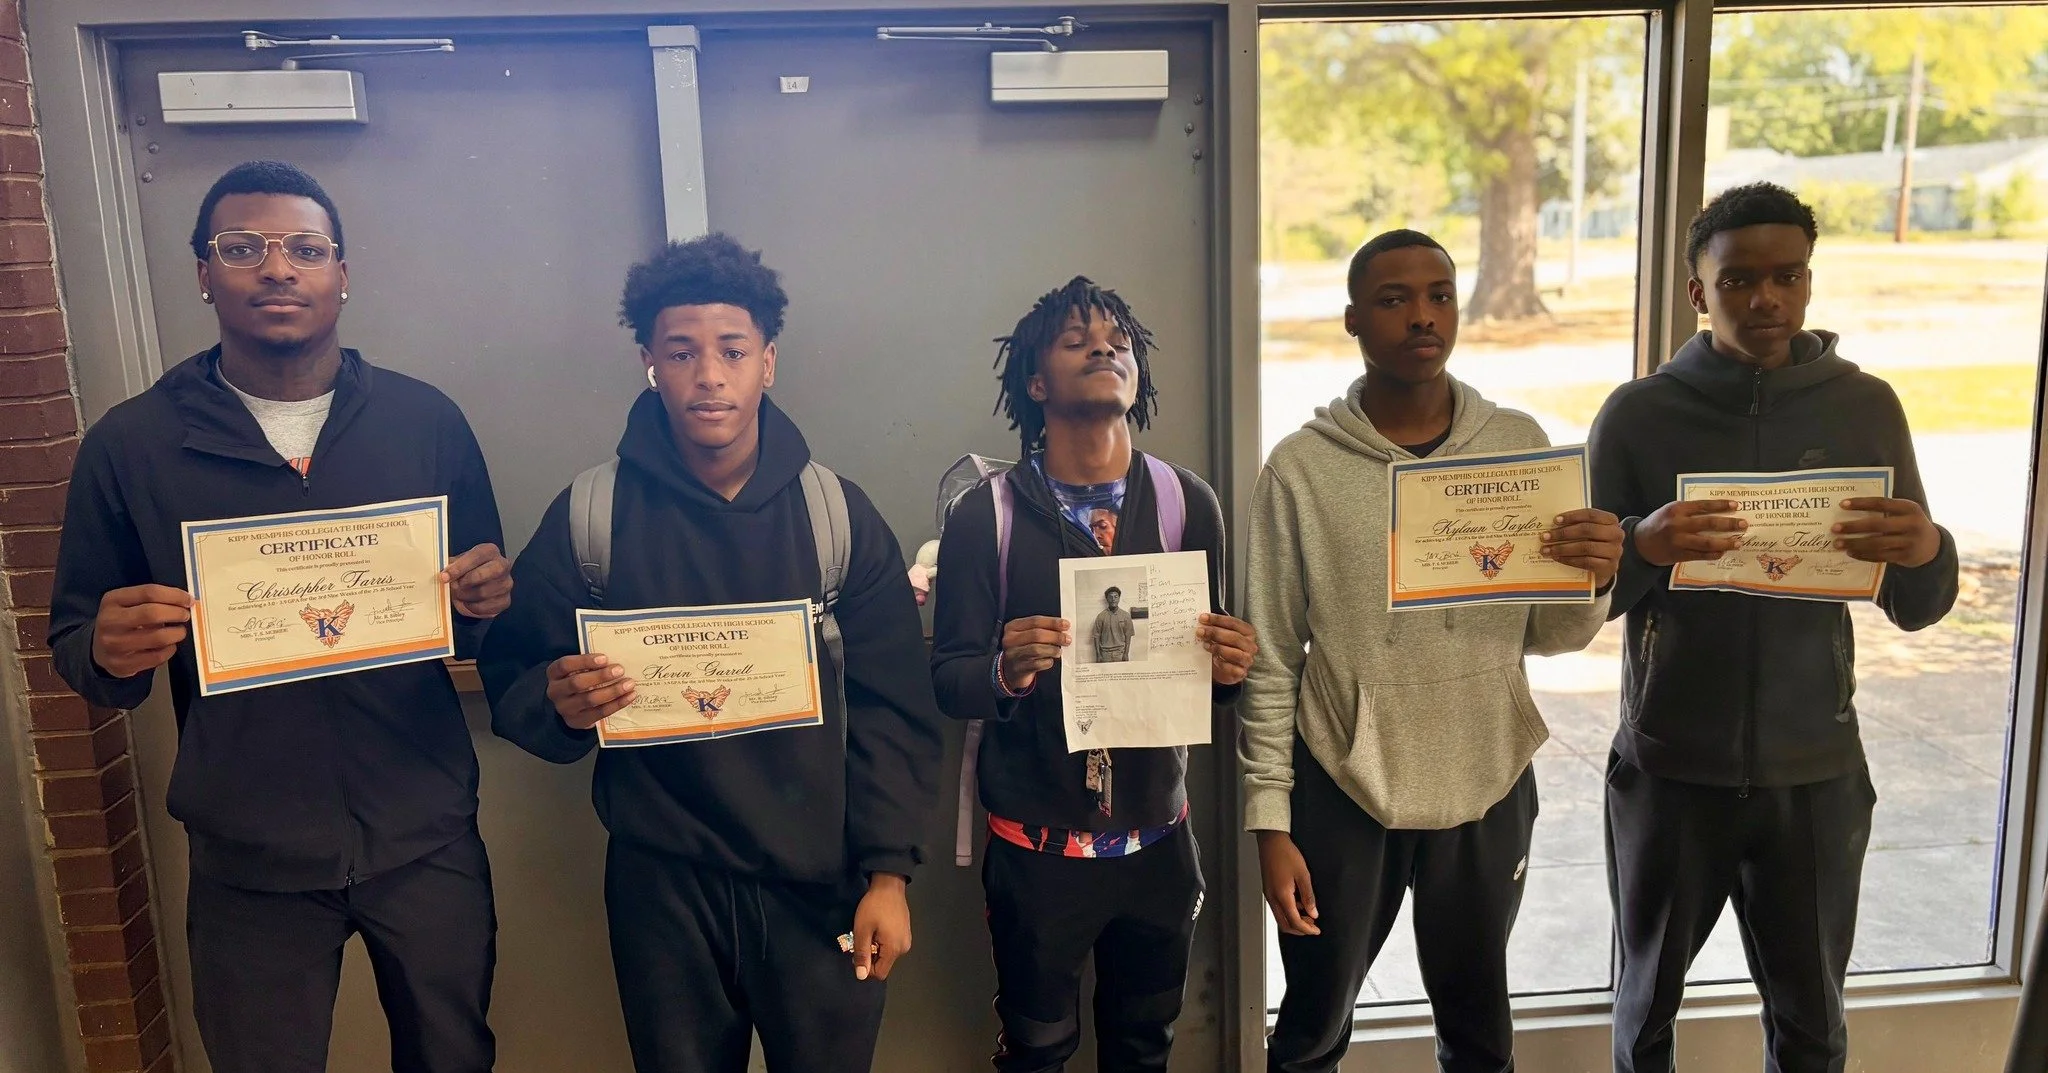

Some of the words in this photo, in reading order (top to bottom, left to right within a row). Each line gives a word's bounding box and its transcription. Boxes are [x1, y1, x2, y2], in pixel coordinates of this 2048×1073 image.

[1438, 473, 1472, 481] MEMPHIS
[1472, 470, 1518, 479] COLLEGIATE
[1520, 468, 1536, 476] HIGH
[1538, 465, 1563, 473] SCHOOL
[1444, 479, 1540, 496] CERTIFICATE
[1760, 487, 1808, 496] COLLEGIATE
[1477, 496, 1502, 504] HONOR
[228, 534, 249, 542] KIPP
[251, 530, 294, 540] MEMPHIS
[295, 525, 352, 536] COLLEGIATE
[376, 520, 409, 528] SCHOOL
[1492, 514, 1543, 534] Taylor
[260, 534, 379, 555] CERTIFICATE
[1783, 531, 1832, 550] Talley
[302, 552, 333, 561] HONOR
[1480, 554, 1503, 570] K
[1764, 560, 1788, 575] K
[237, 576, 336, 601] Christopher
[315, 616, 343, 638] K
[634, 623, 671, 632] MEMPHIS
[672, 621, 723, 630] COLLEGIATE
[643, 630, 749, 645] CERTIFICATE
[642, 664, 692, 679] Kevin
[698, 697, 723, 712] K
